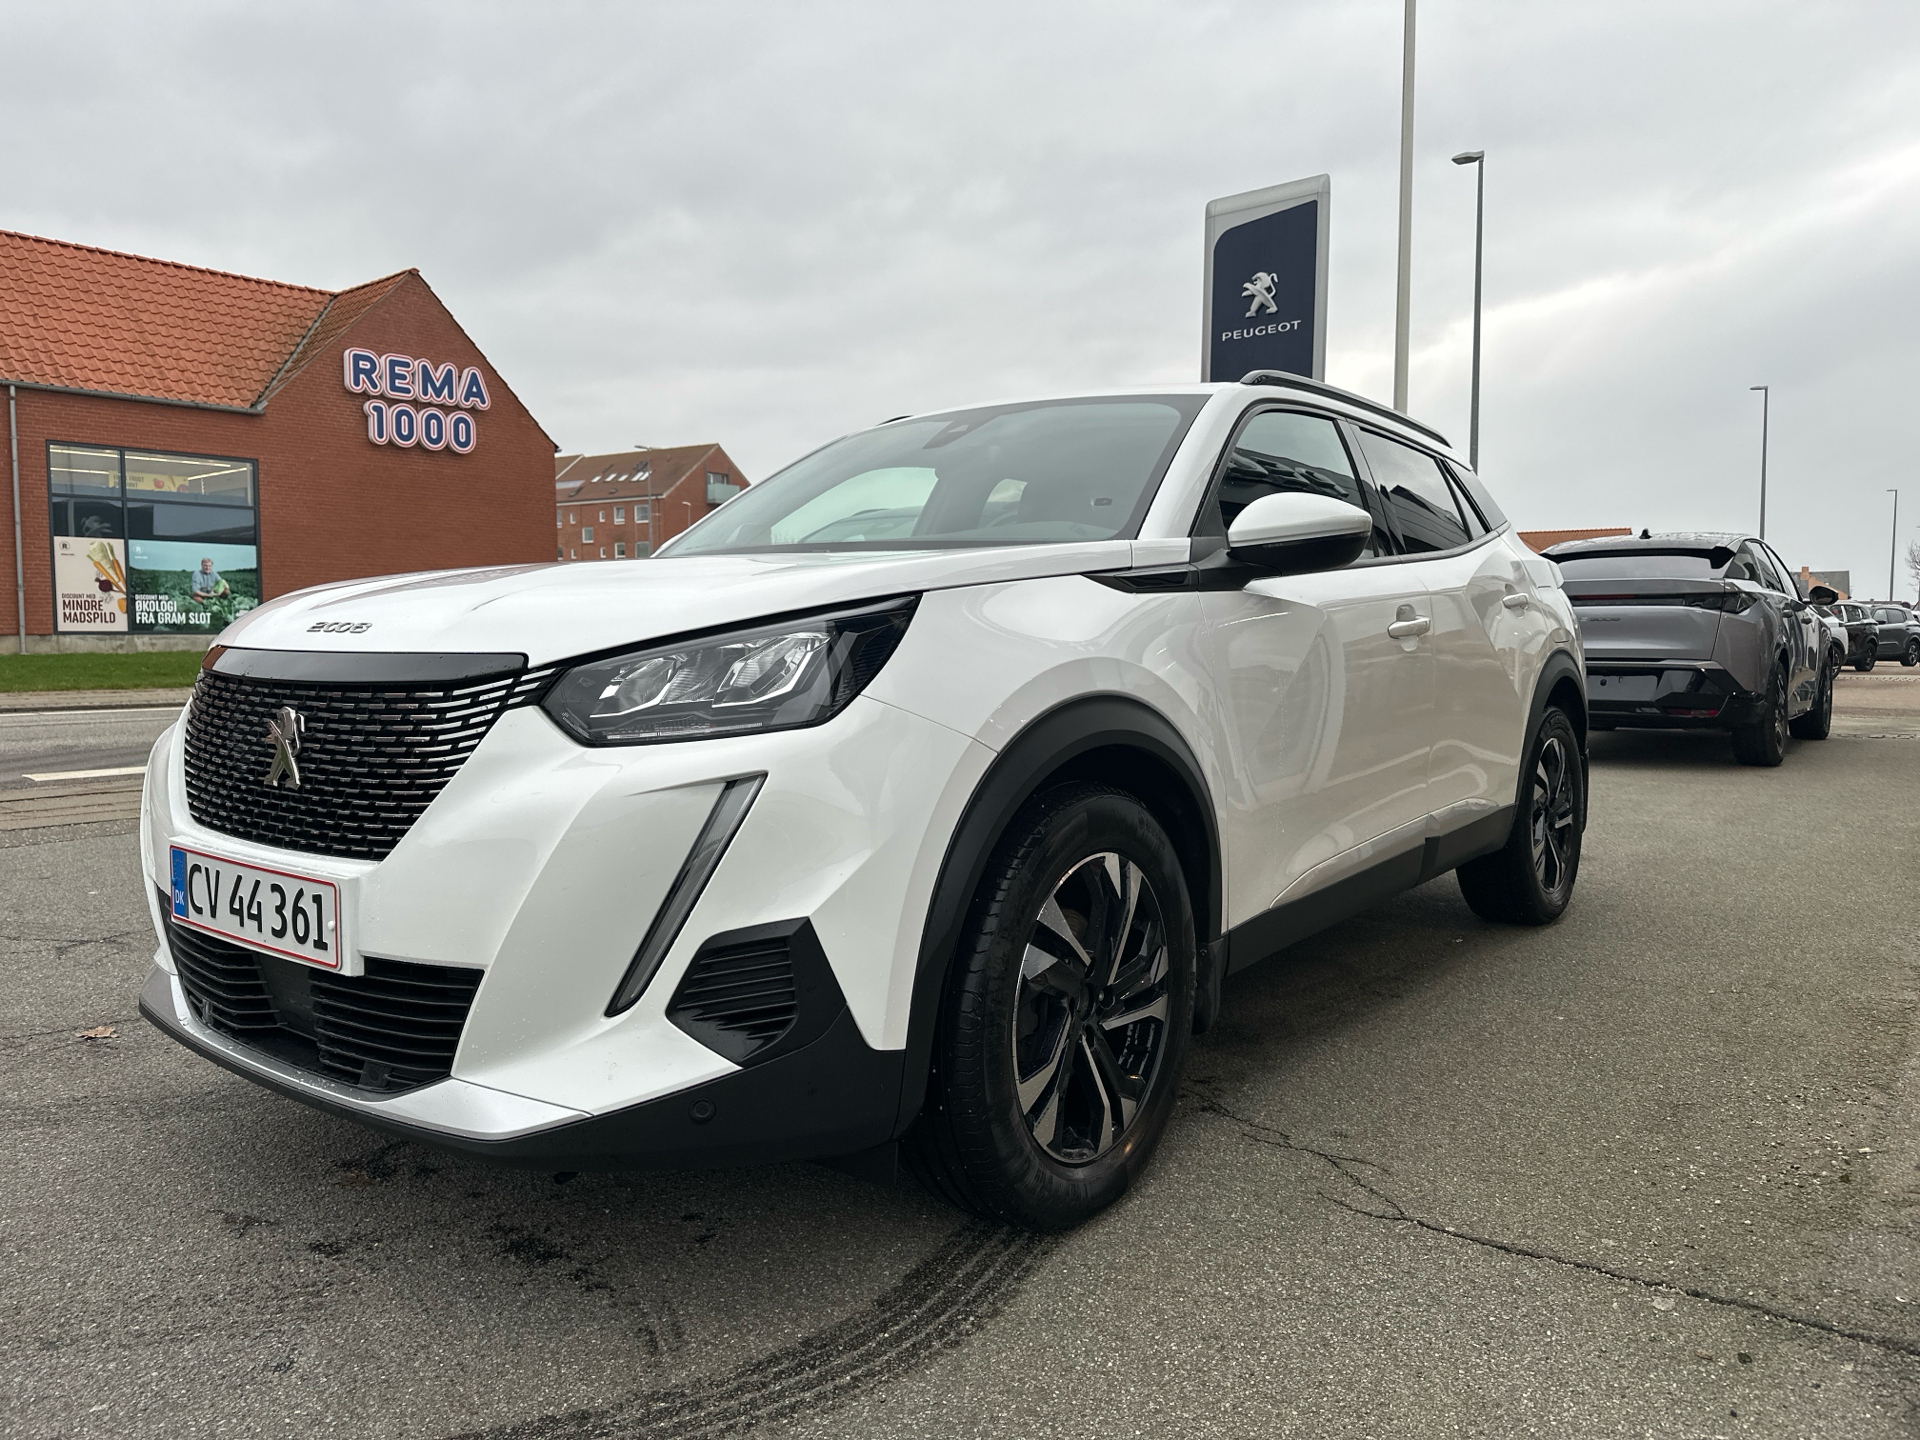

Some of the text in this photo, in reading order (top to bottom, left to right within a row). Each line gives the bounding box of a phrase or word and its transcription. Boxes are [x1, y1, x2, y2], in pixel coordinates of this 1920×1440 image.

[1221, 320, 1302, 342] PEUGEOT
[348, 350, 489, 408] REMA
[367, 402, 474, 451] 1000
[62, 600, 104, 611] MINDRE
[135, 600, 177, 612] ØKOLOGI
[63, 612, 115, 623] MADSPILD
[135, 612, 212, 625] FRA GRAM SLOT
[307, 622, 372, 633] 2008
[175, 889, 185, 906] DK
[189, 863, 221, 919] CV
